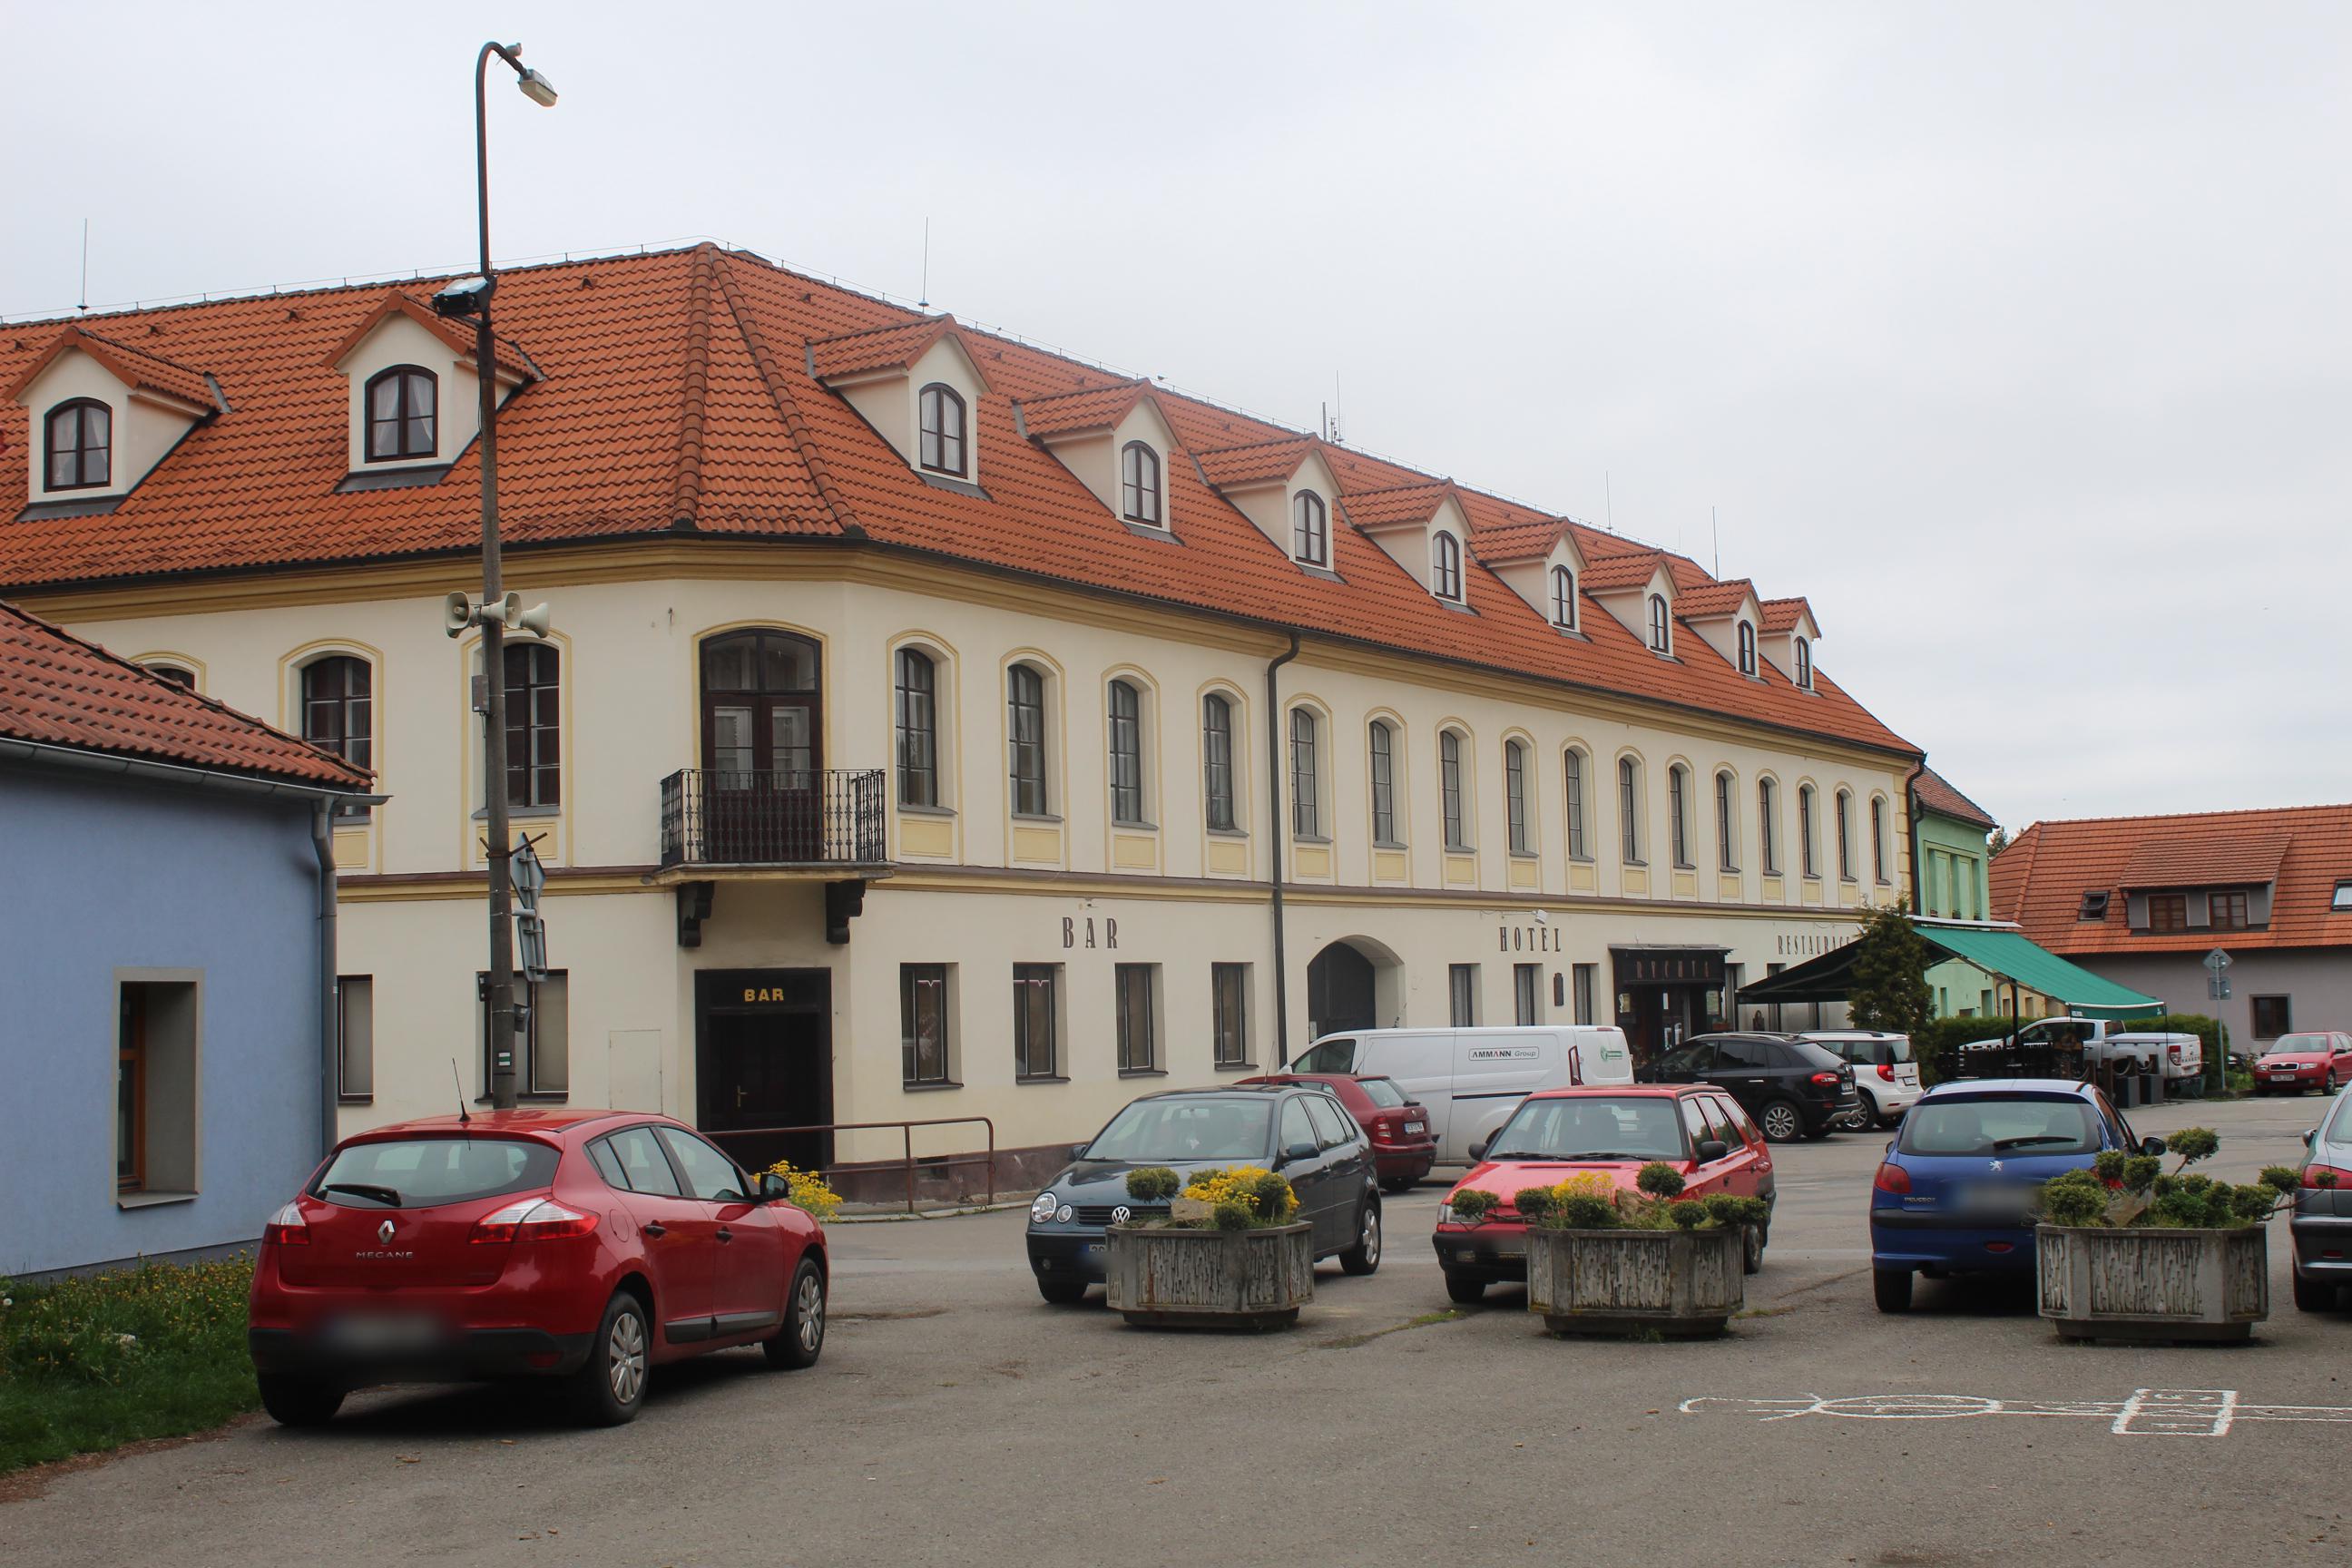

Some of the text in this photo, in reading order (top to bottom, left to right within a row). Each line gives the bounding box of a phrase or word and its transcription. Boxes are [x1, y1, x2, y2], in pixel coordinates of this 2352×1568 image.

[1063, 916, 1117, 948] BAR
[1499, 926, 1561, 952] HOTEL
[744, 987, 784, 1002] BAR
[356, 1251, 414, 1259] MEGANE
